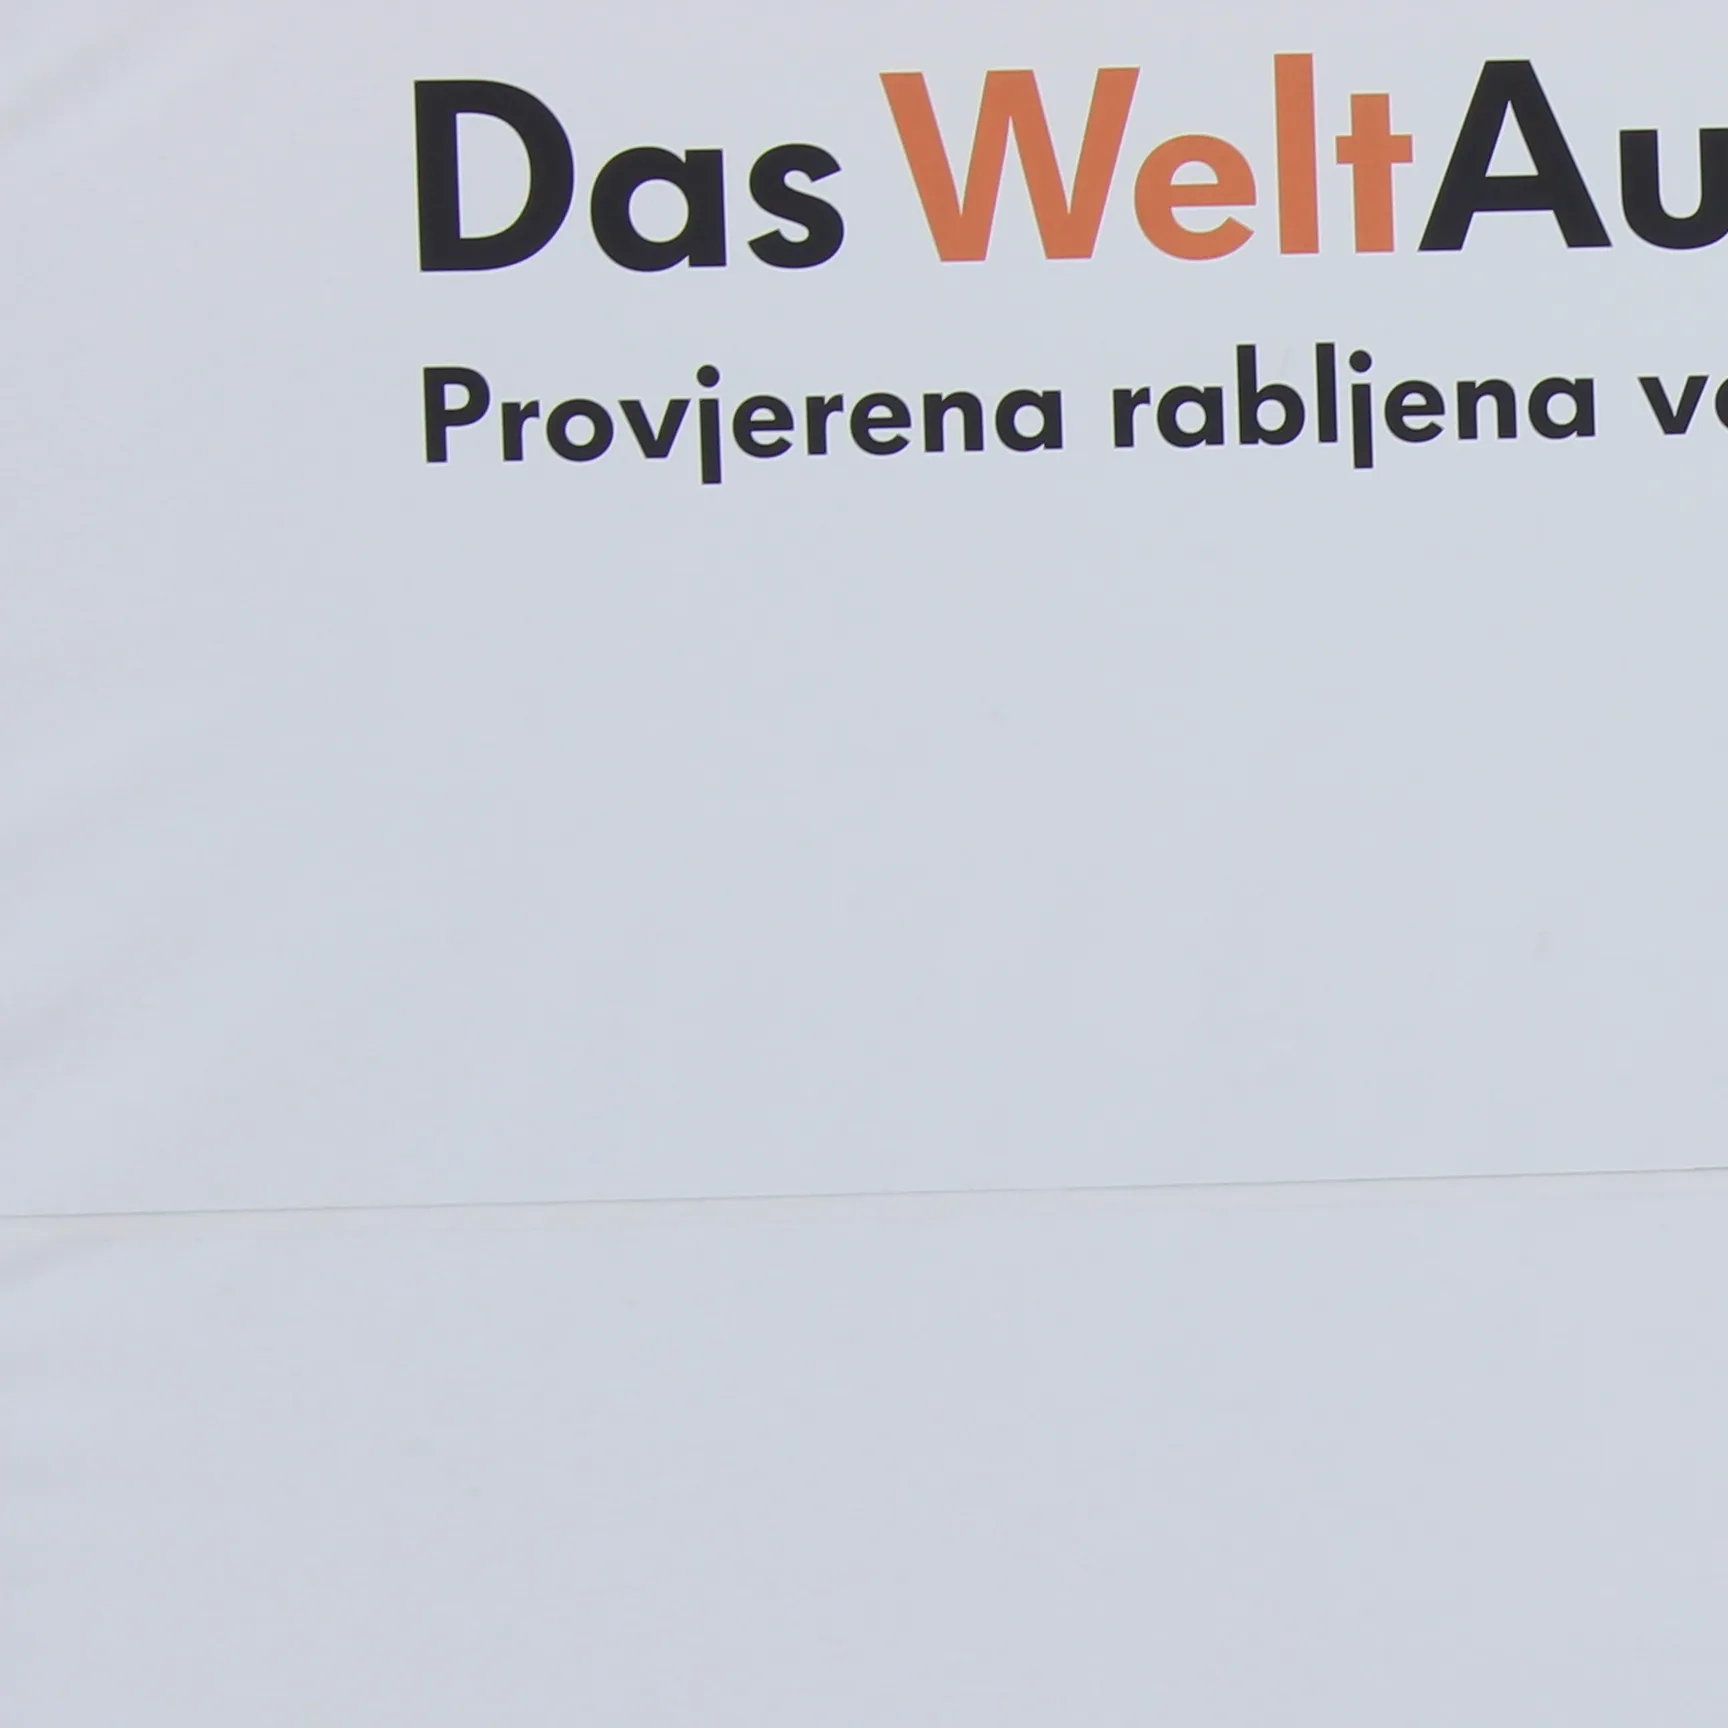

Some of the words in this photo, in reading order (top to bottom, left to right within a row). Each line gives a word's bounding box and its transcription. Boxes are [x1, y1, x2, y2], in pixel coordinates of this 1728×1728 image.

[413, 79, 845, 273] Das
[422, 364, 1064, 485] Provjerena
[1112, 342, 1596, 470] rabljena
